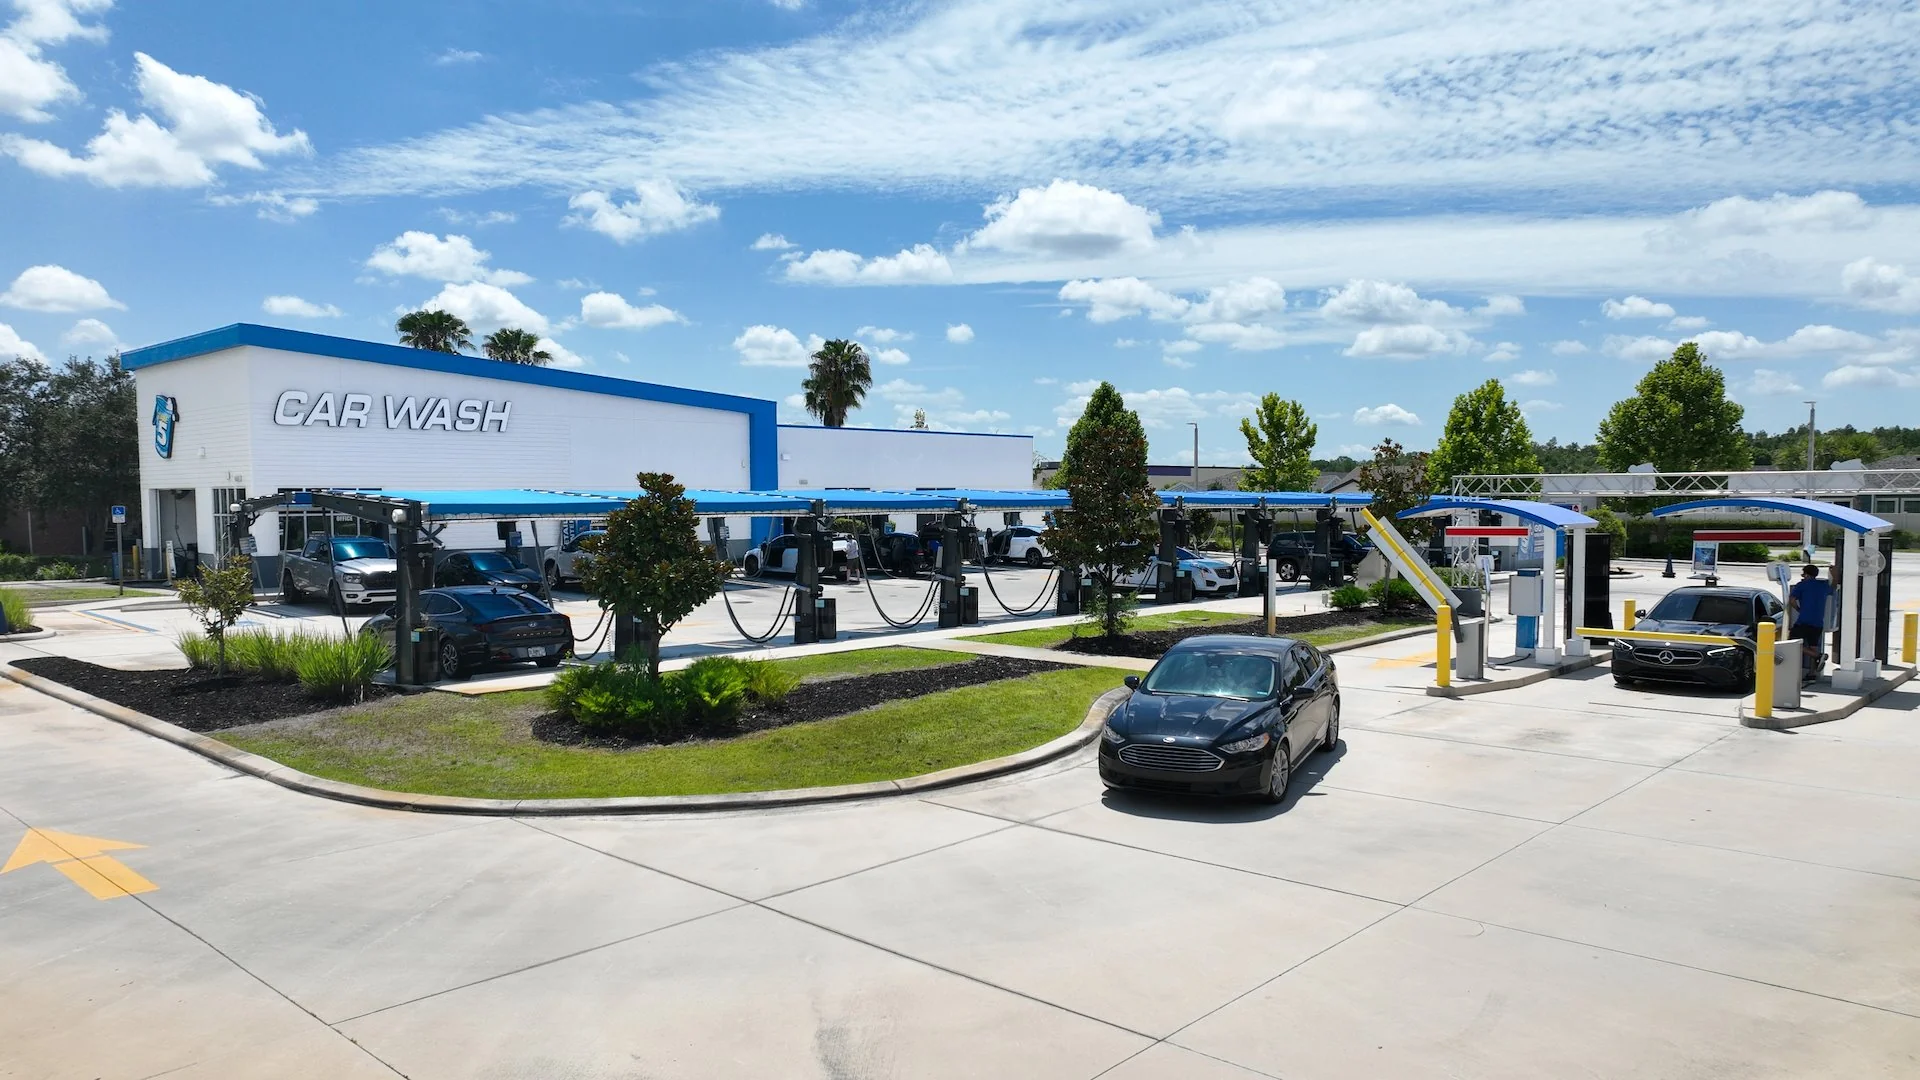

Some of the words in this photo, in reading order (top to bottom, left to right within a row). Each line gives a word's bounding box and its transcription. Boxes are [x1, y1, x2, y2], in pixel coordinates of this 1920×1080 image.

[274, 389, 372, 428] CAR
[384, 395, 512, 433] WASH
[157, 420, 168, 446] 5
